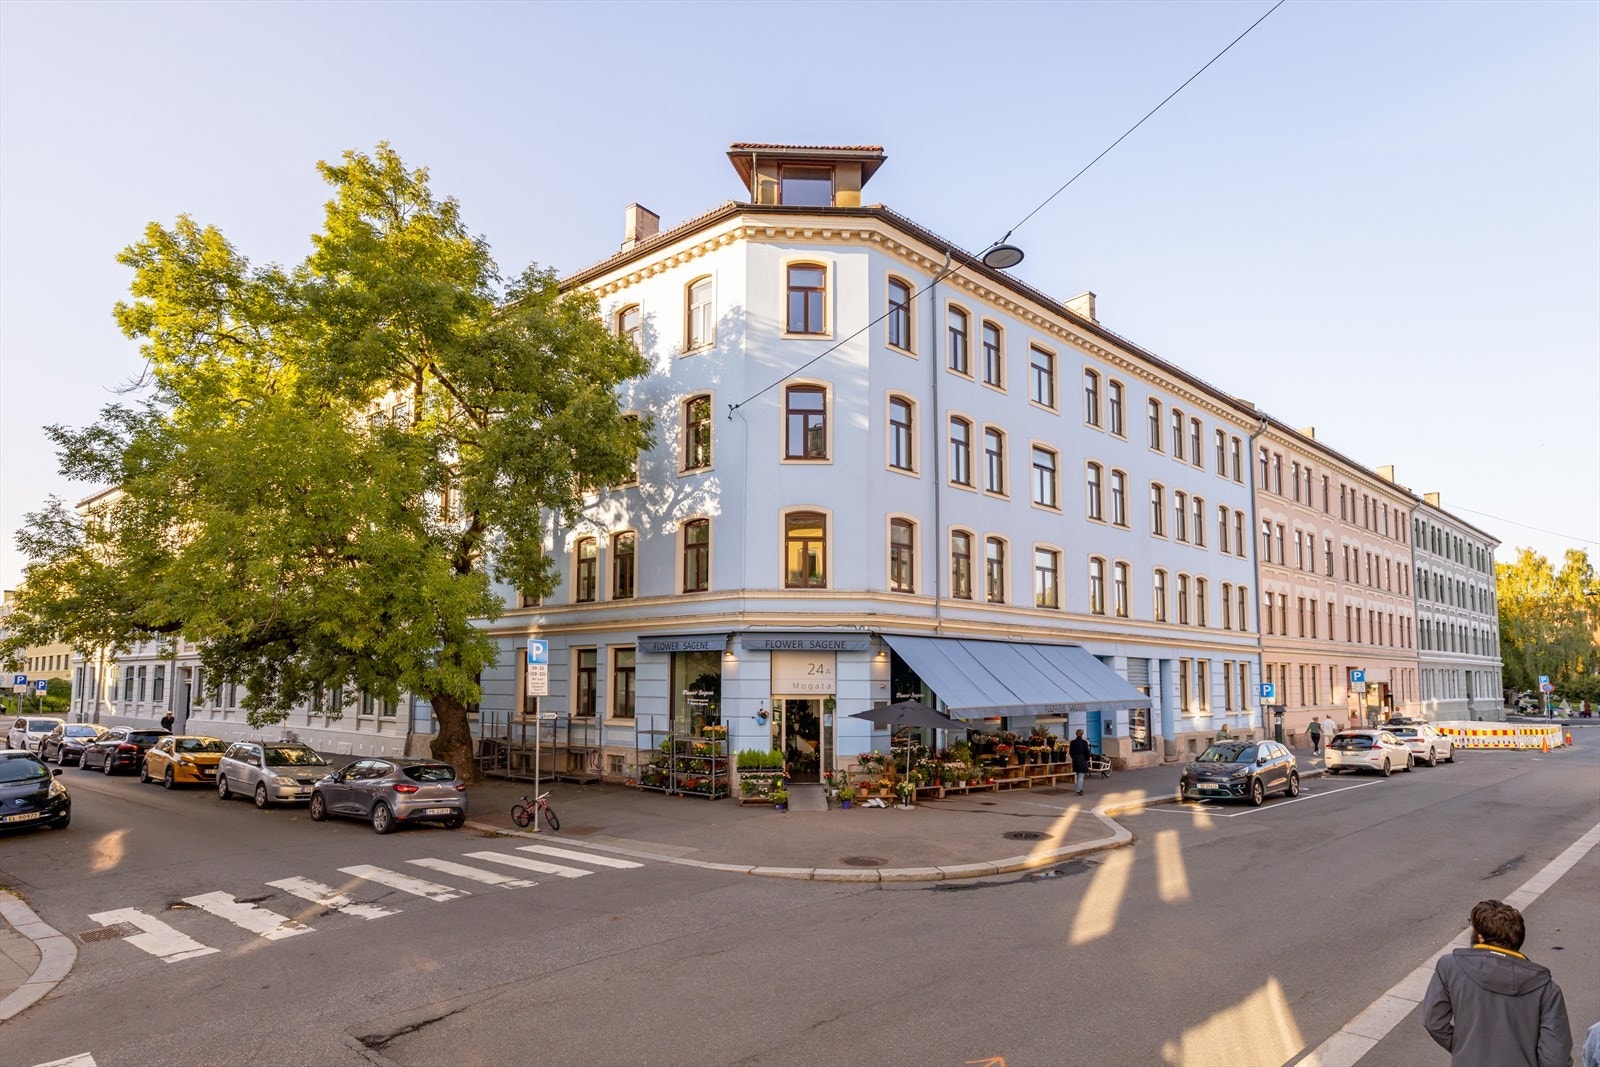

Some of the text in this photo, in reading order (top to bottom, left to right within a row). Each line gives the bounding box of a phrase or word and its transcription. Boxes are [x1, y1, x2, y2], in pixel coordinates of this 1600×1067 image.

[653, 641, 709, 651] FLOWER SAGENE
[765, 640, 847, 649] FLOWER SAGENE
[533, 643, 544, 661] P
[17, 676, 25, 684] P
[1354, 671, 1362, 681] P
[38, 681, 45, 690] P
[792, 682, 832, 691] Mogata
[1263, 685, 1272, 696] P
